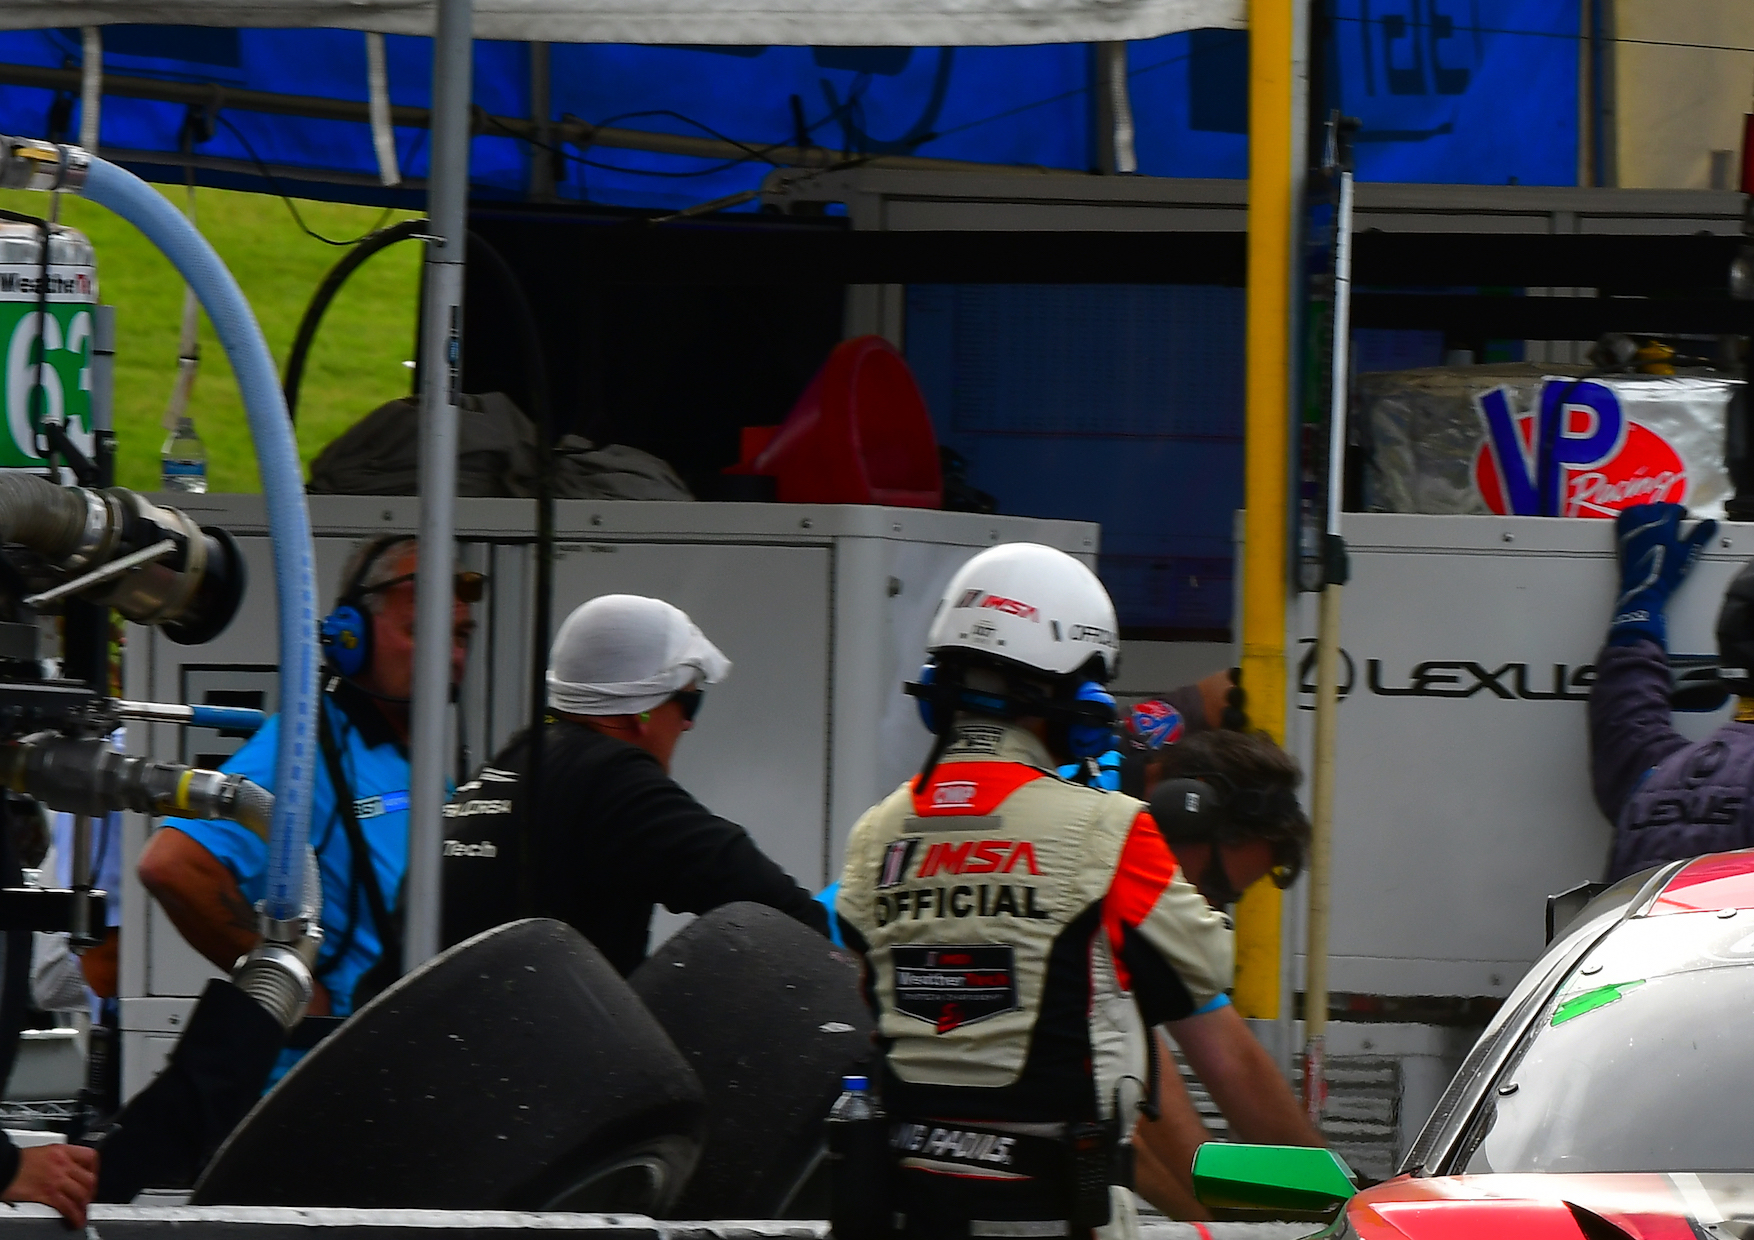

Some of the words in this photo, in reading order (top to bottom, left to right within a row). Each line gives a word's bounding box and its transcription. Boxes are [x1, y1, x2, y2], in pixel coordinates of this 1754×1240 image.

[1476, 376, 1625, 516] VP
[1569, 465, 1686, 517] Racing
[1629, 798, 1742, 829] LEXUS
[916, 840, 1047, 878] IMSA
[873, 884, 1050, 928] OFFICIAL
